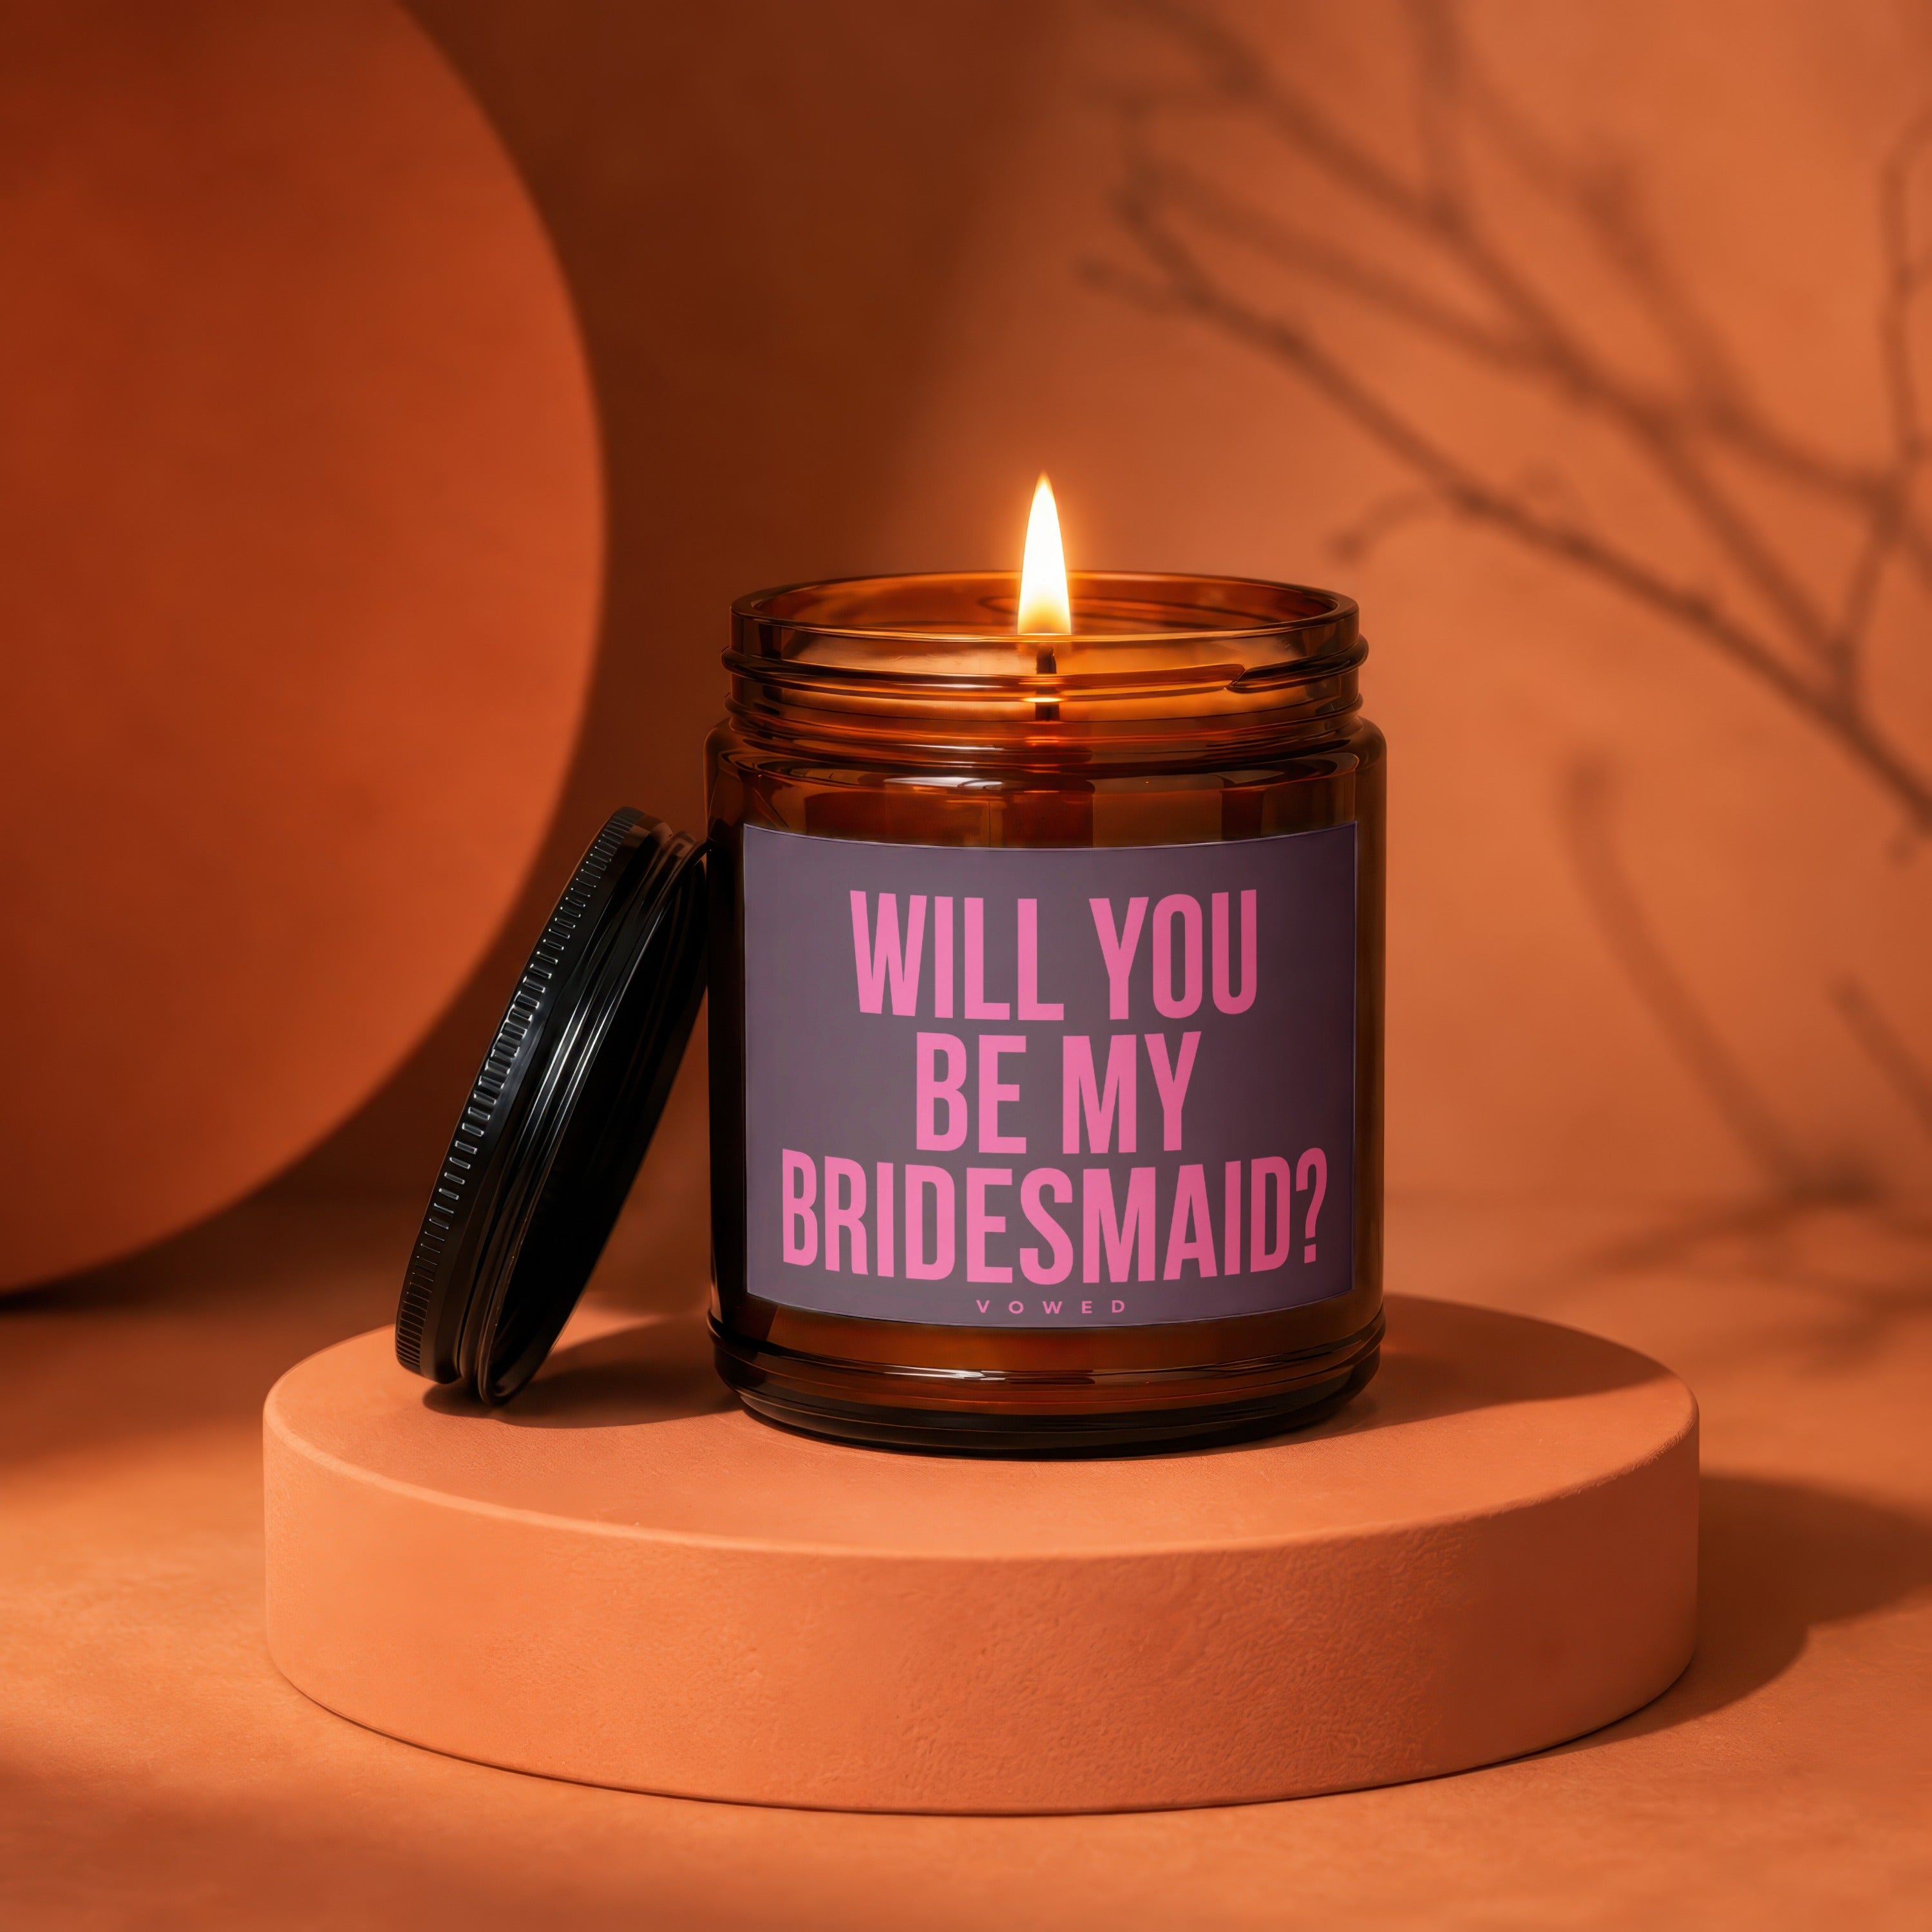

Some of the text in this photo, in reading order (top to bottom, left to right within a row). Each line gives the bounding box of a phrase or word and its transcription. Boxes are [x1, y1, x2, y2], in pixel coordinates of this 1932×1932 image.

[850, 889, 1257, 1021] WILL YOU
[916, 1031, 1202, 1155] BE MY
[782, 1148, 1327, 1285] BRIDESMAID?
[976, 1300, 1125, 1314] VOWED
